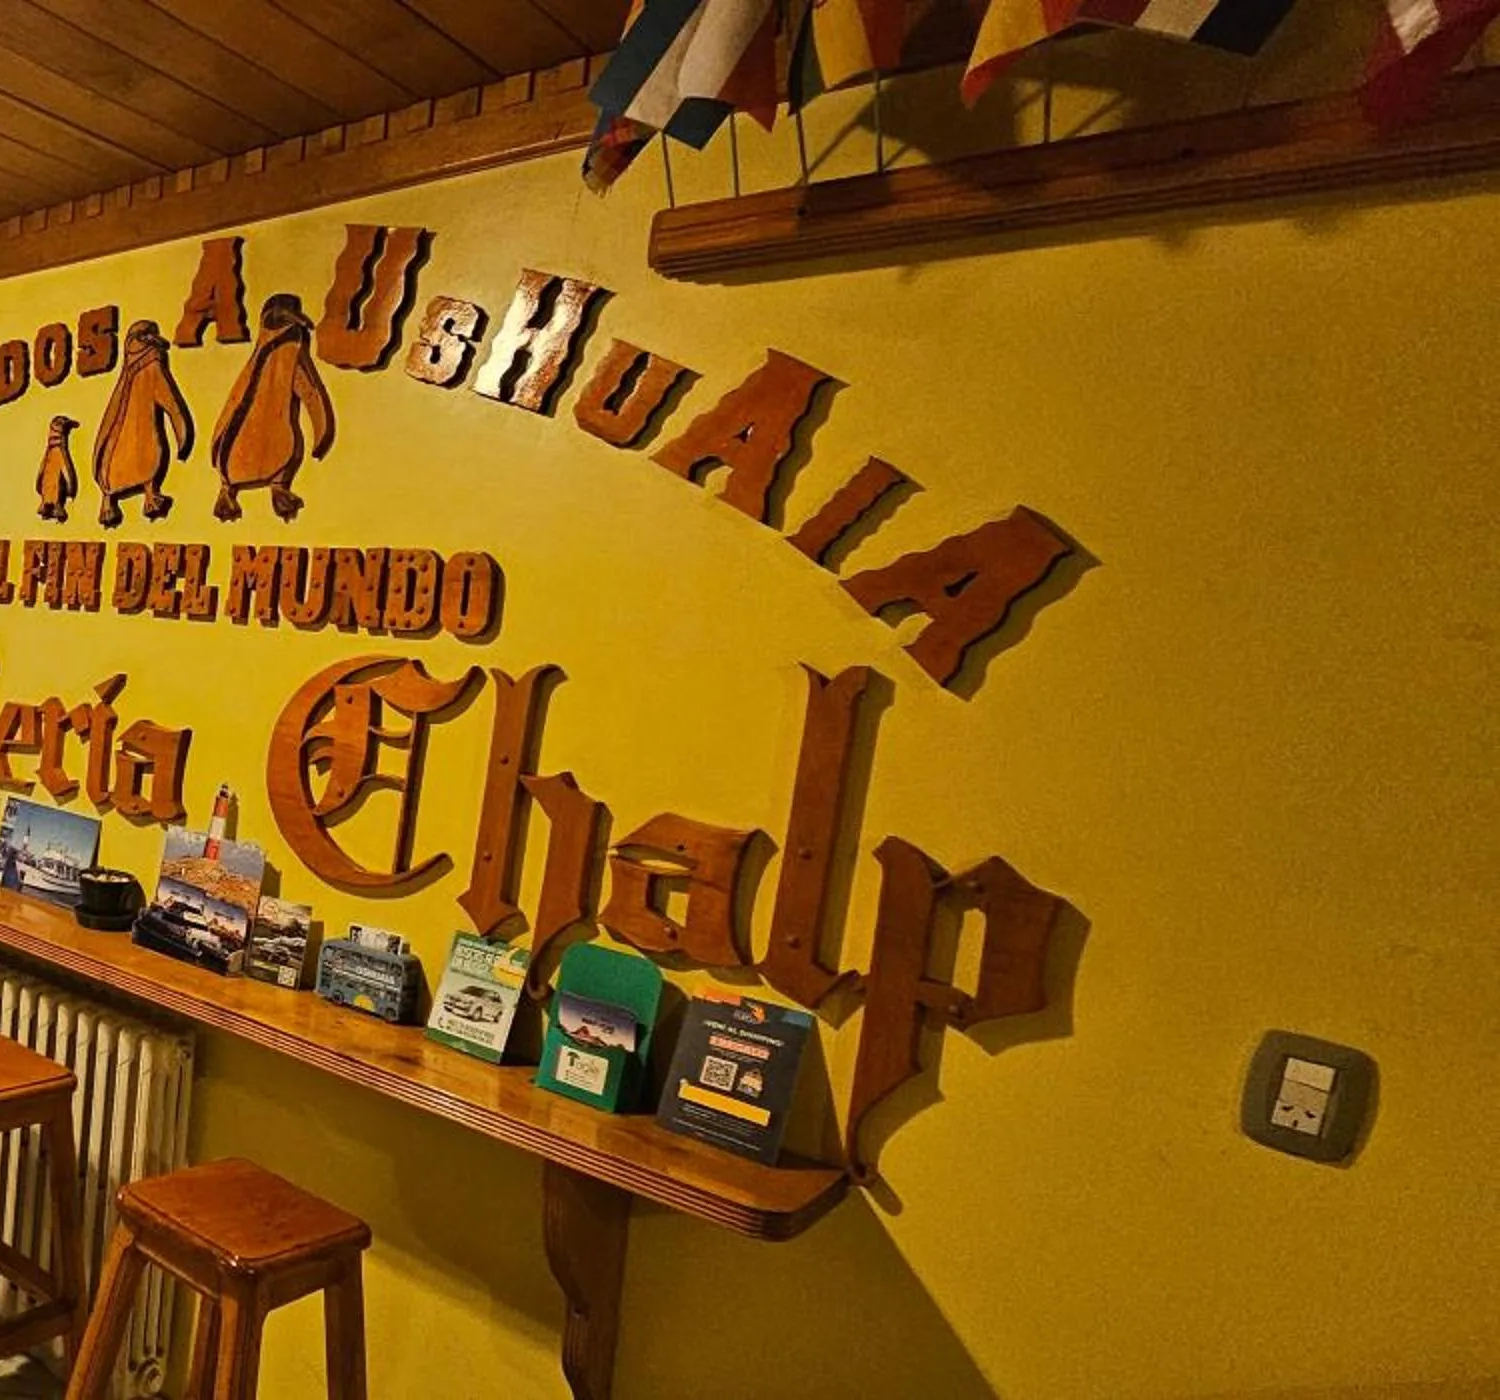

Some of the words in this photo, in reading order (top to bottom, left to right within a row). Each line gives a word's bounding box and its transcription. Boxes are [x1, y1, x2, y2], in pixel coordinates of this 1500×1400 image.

[175, 236, 251, 348] A
[21, 540, 106, 612] FIN
[111, 541, 219, 622] DEL
[229, 544, 506, 642] MUNDO
